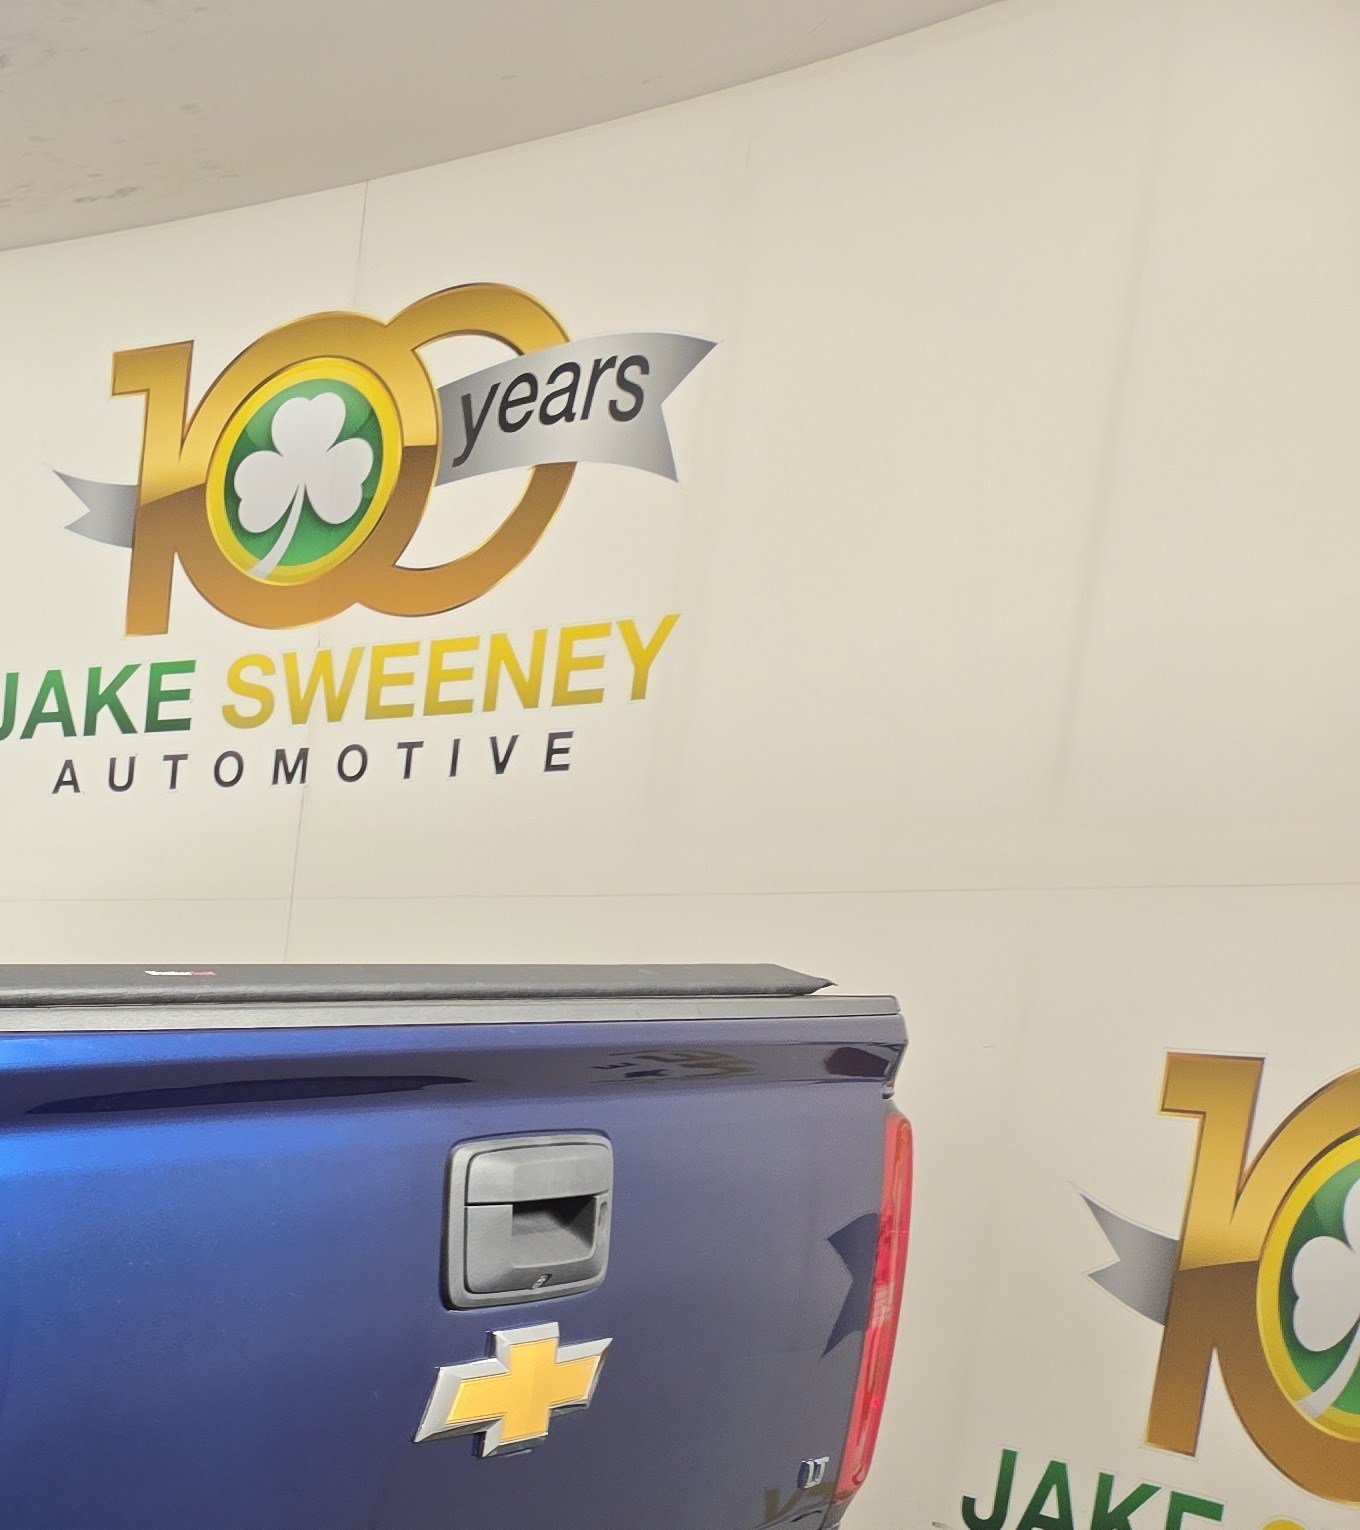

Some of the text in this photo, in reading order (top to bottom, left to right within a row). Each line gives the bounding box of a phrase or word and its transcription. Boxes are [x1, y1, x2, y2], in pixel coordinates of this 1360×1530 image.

[112, 282, 651, 636] 100 years
[221, 613, 683, 730] SWEENEY
[52, 730, 576, 795] AUTOMOTIVE
